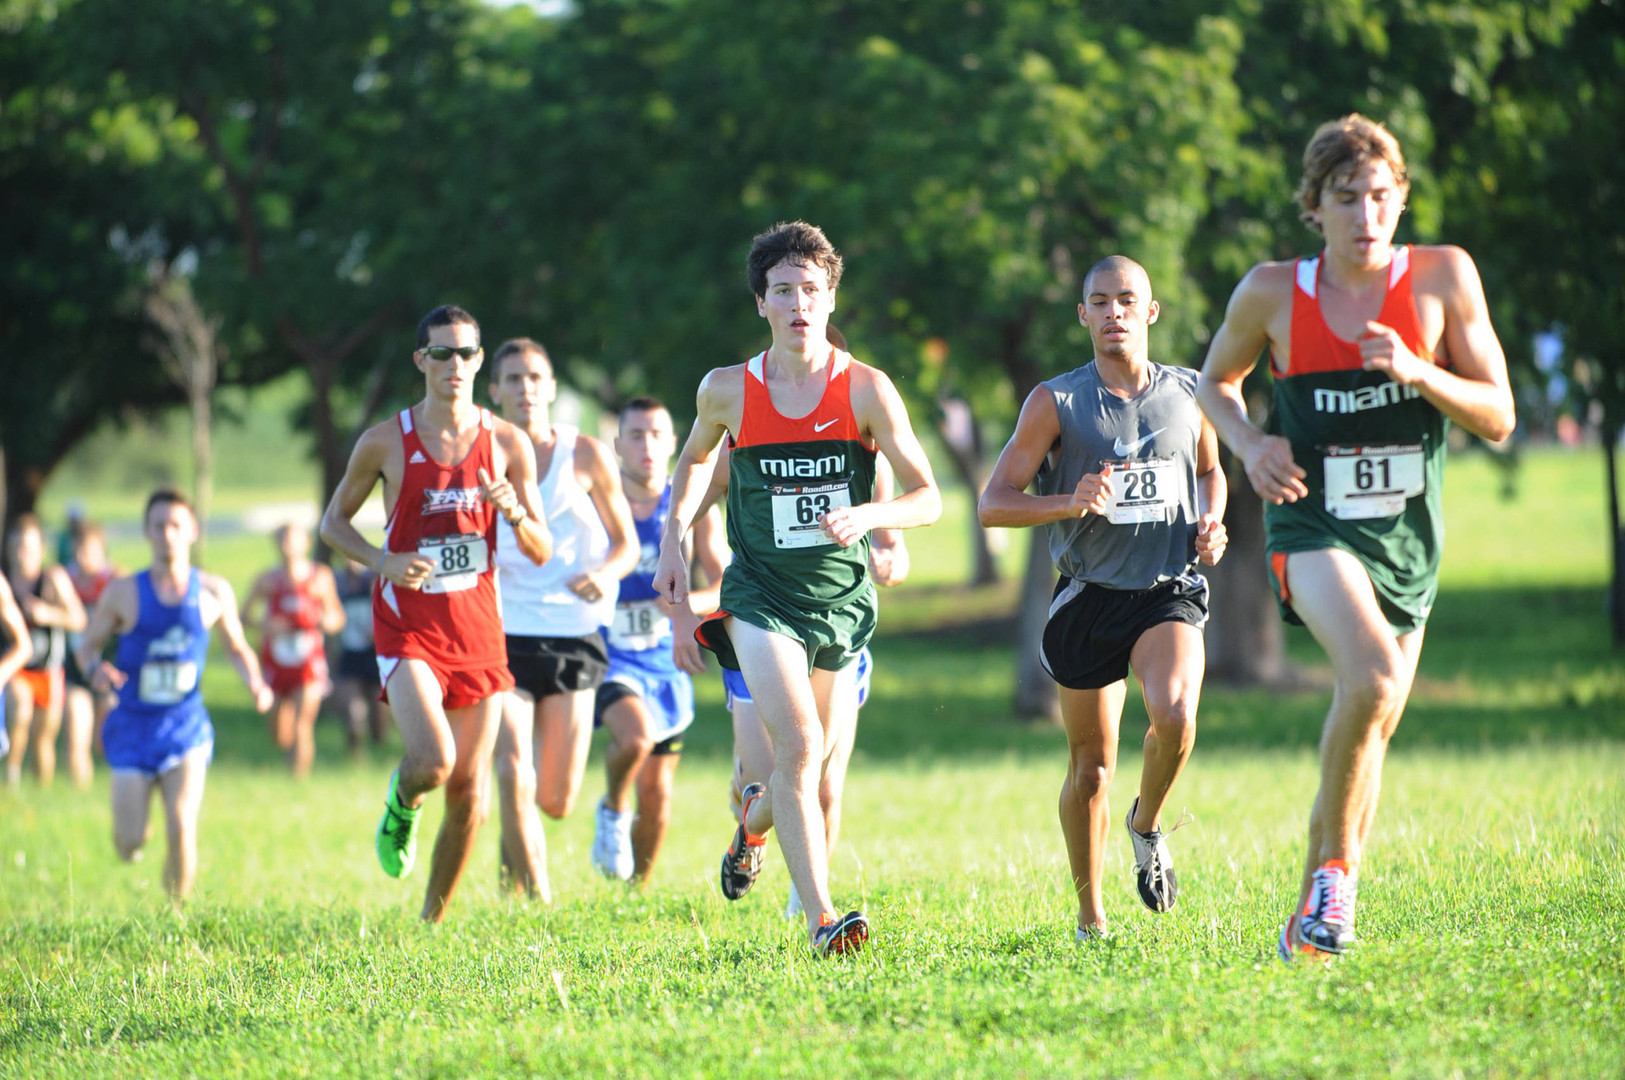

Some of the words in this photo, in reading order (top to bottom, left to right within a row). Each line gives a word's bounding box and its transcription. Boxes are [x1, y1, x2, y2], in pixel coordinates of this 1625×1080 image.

[1124, 470, 1157, 501] 28
[1355, 458, 1390, 490] 61
[796, 494, 831, 525] 63
[441, 544, 470, 571] 88
[627, 609, 651, 632] 16
